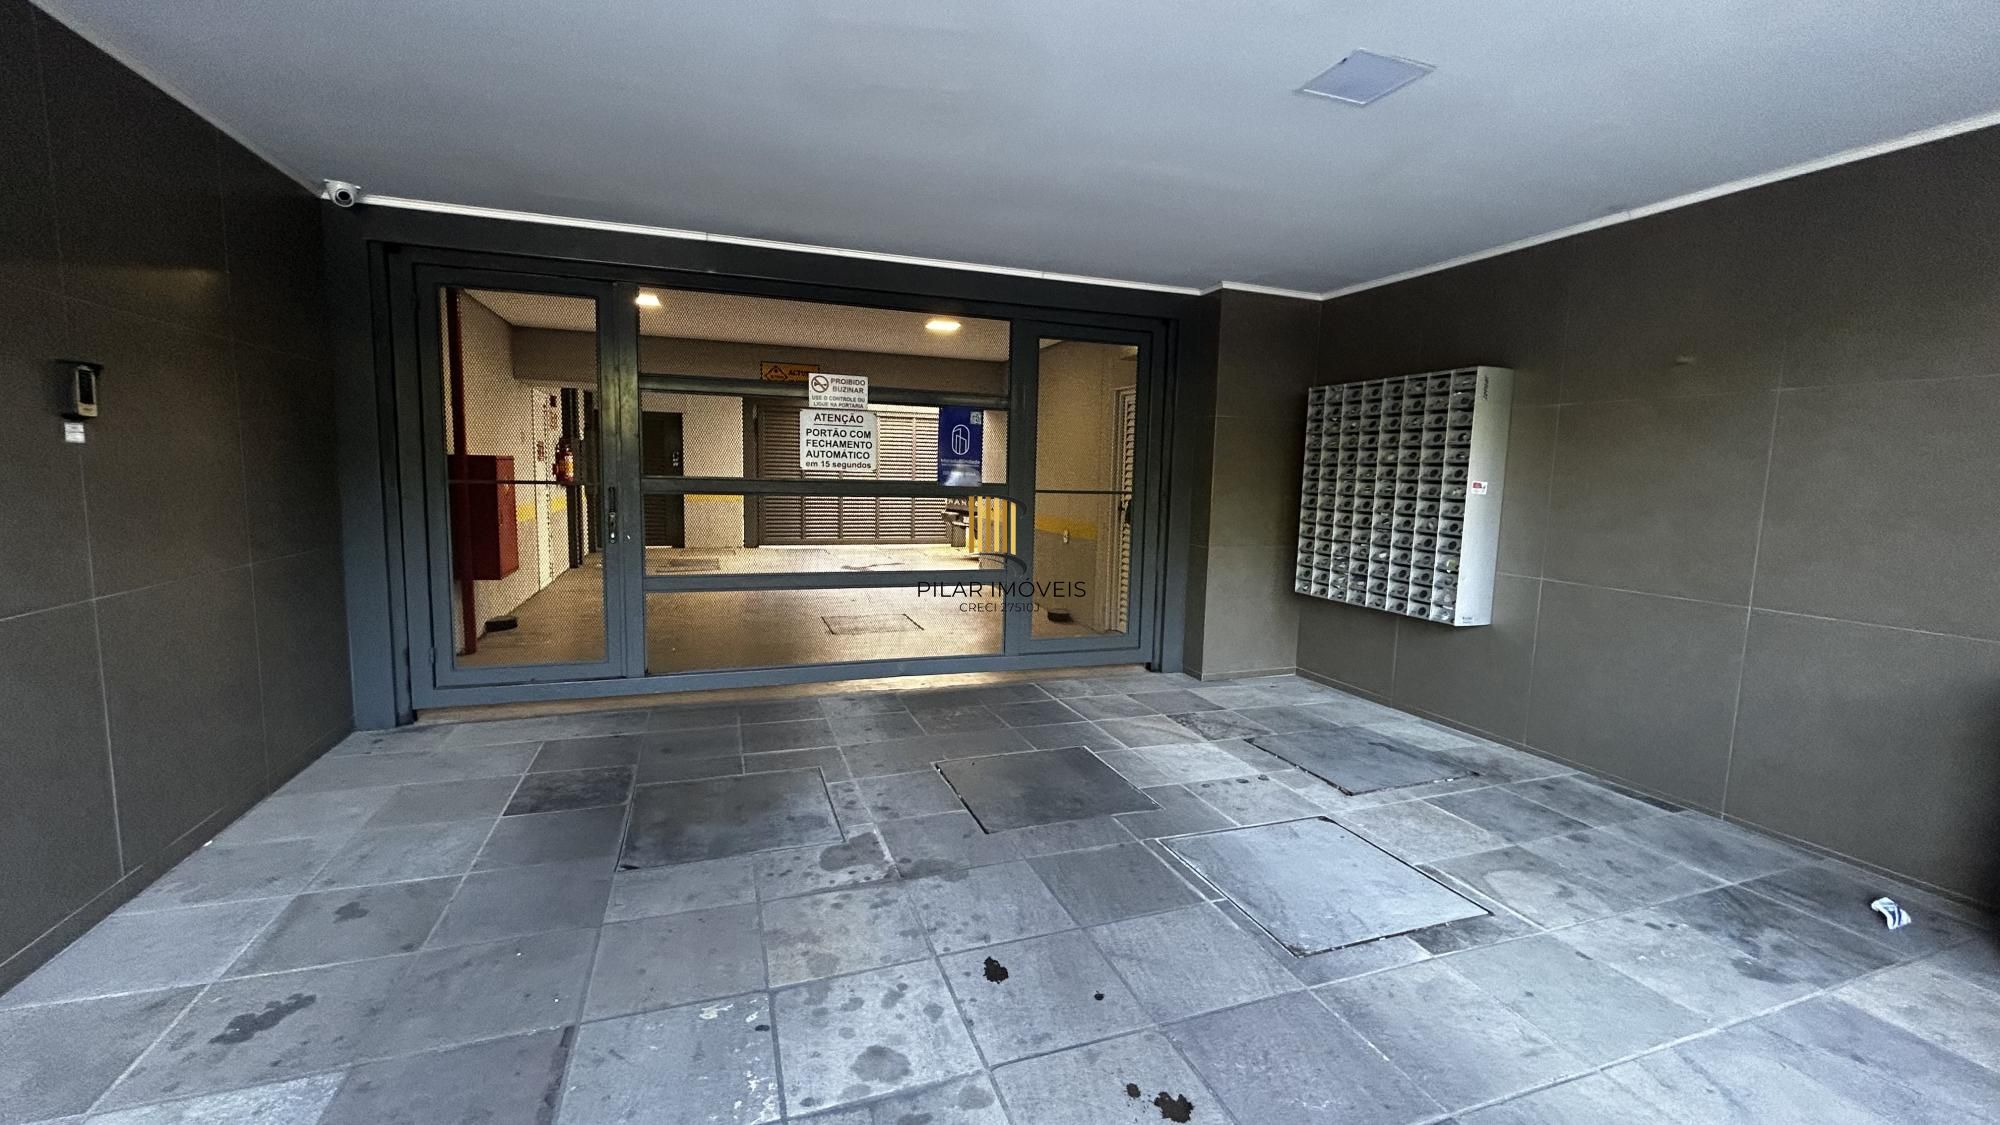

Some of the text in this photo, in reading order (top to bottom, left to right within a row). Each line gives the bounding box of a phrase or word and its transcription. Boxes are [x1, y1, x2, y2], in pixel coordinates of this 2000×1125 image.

[830, 377, 866, 386] PROIBIDO
[832, 386, 864, 394] BUZINAR
[813, 412, 864, 424] ATENÇÃO
[805, 427, 872, 439] PORTÃO COM
[806, 439, 873, 449] FECHAMENTO
[805, 449, 870, 460] AUTOMÁTICO
[820, 460, 831, 468] 15
[832, 461, 872, 470] segundos
